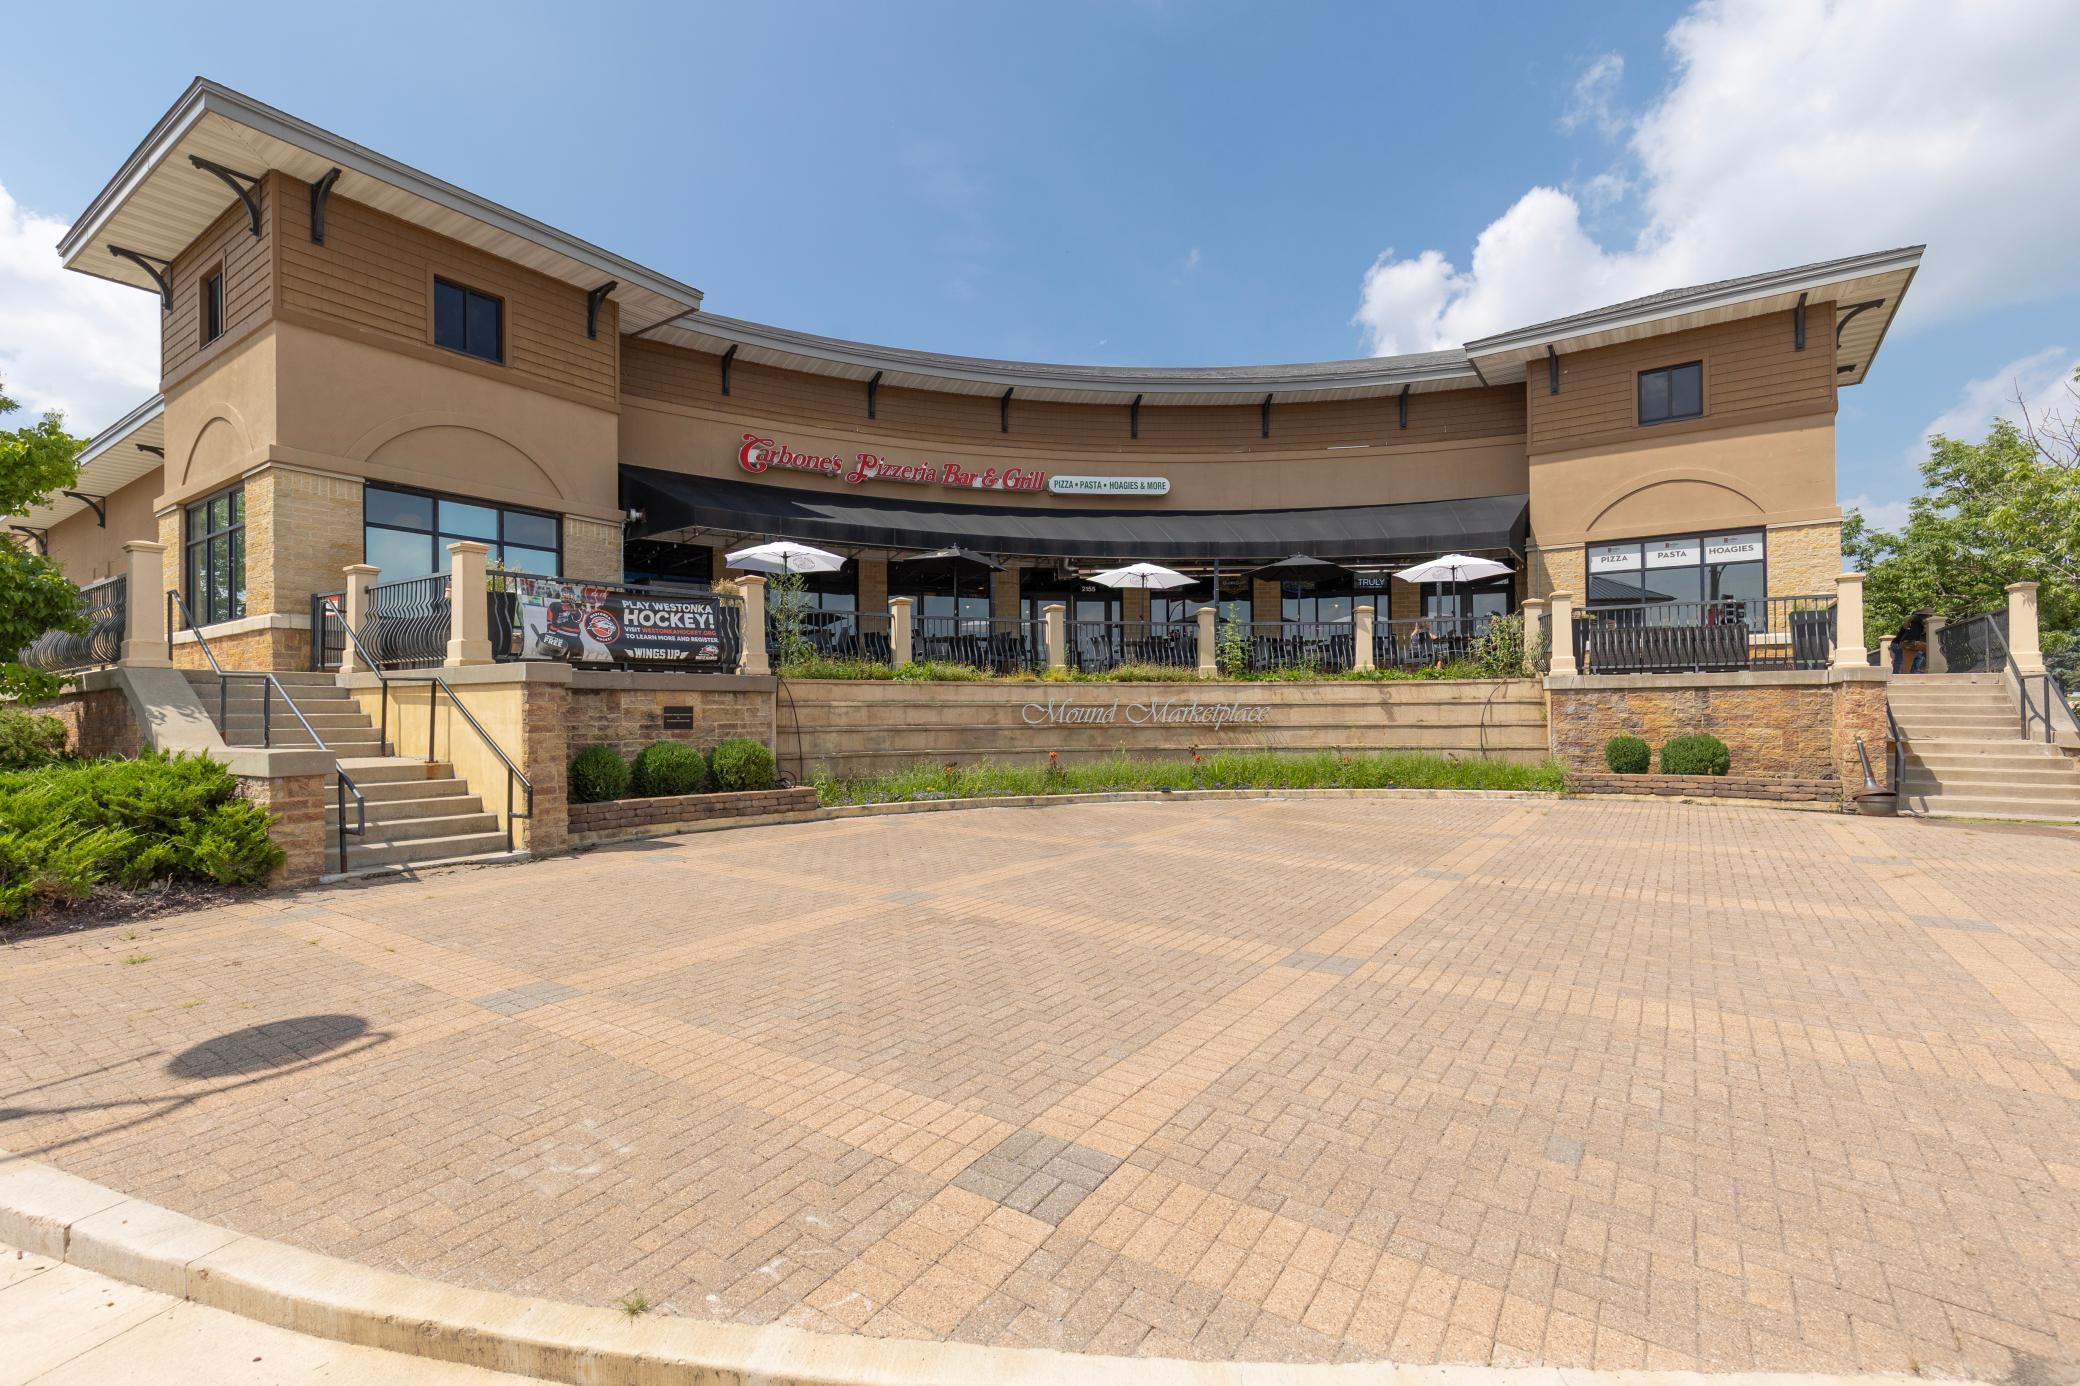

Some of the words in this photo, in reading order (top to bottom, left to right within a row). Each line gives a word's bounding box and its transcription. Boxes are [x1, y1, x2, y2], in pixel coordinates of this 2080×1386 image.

[739, 433, 843, 473] Carbone's
[845, 453, 937, 484] Pizzeria
[943, 463, 978, 486] Bar
[982, 468, 999, 488] &
[1001, 466, 1046, 490] Grill
[1054, 480, 1074, 489] PIZZA
[1080, 480, 1102, 489] PASTA
[1109, 481, 1139, 490] HOAGIES
[1140, 482, 1145, 490] &
[1147, 482, 1167, 490] MORE
[1657, 550, 1687, 559] PASTA
[1709, 544, 1754, 555] HOAGIES
[1600, 554, 1628, 564] PIZZA
[1358, 578, 1385, 586] TRULY
[622, 600, 650, 610] PLAY
[652, 602, 713, 614] WESTONKA
[623, 609, 715, 629] HOCKEY!
[641, 627, 716, 636] WESTONKAHOCKEY.ORG
[544, 637, 563, 648] FREE
[633, 647, 666, 659] WINGS
[667, 648, 681, 659] UP
[1022, 698, 1120, 724] Mound
[1126, 697, 1271, 731] Marketplace
